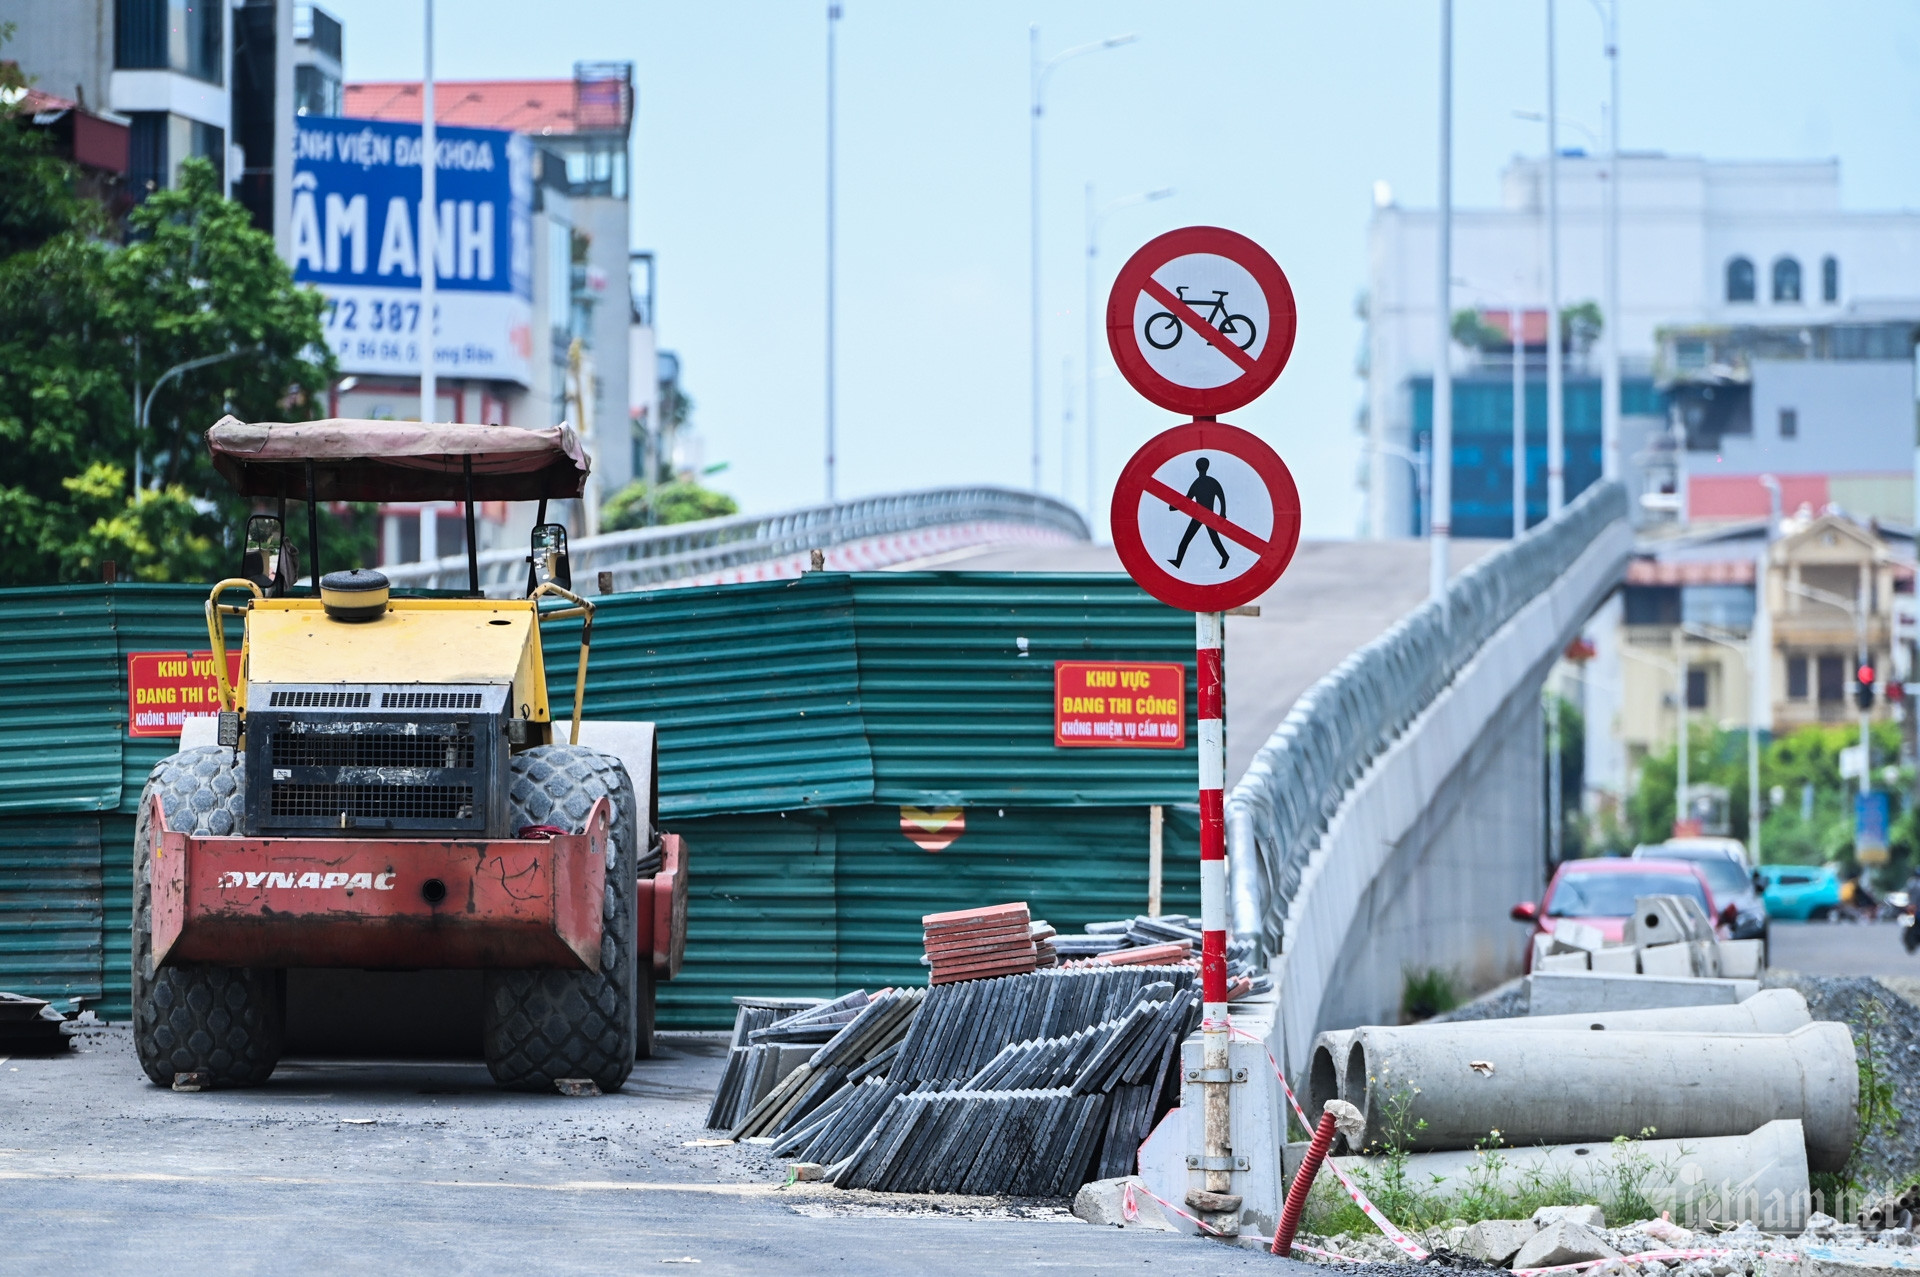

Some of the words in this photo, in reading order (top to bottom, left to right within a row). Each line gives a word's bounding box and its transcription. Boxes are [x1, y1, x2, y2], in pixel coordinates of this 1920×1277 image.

[336, 126, 392, 171] VIỆN
[377, 196, 495, 281] ANH
[158, 661, 187, 677] KHU
[1086, 670, 1117, 688] KHU
[1120, 670, 1150, 691] VỰC
[136, 688, 176, 704] ĐANG
[180, 687, 203, 703] THI
[1062, 697, 1105, 714] ĐANG
[1108, 698, 1132, 714] THI
[1136, 695, 1177, 715] CÔNG
[136, 710, 165, 726] KHÔNG
[1061, 719, 1092, 736] KHÔNG
[1093, 719, 1123, 739] NHIỆM
[1124, 723, 1137, 739] VỤ
[1138, 719, 1159, 737] CẤM
[1160, 721, 1178, 738] VÀO
[218, 871, 397, 890] DYNAPAC
